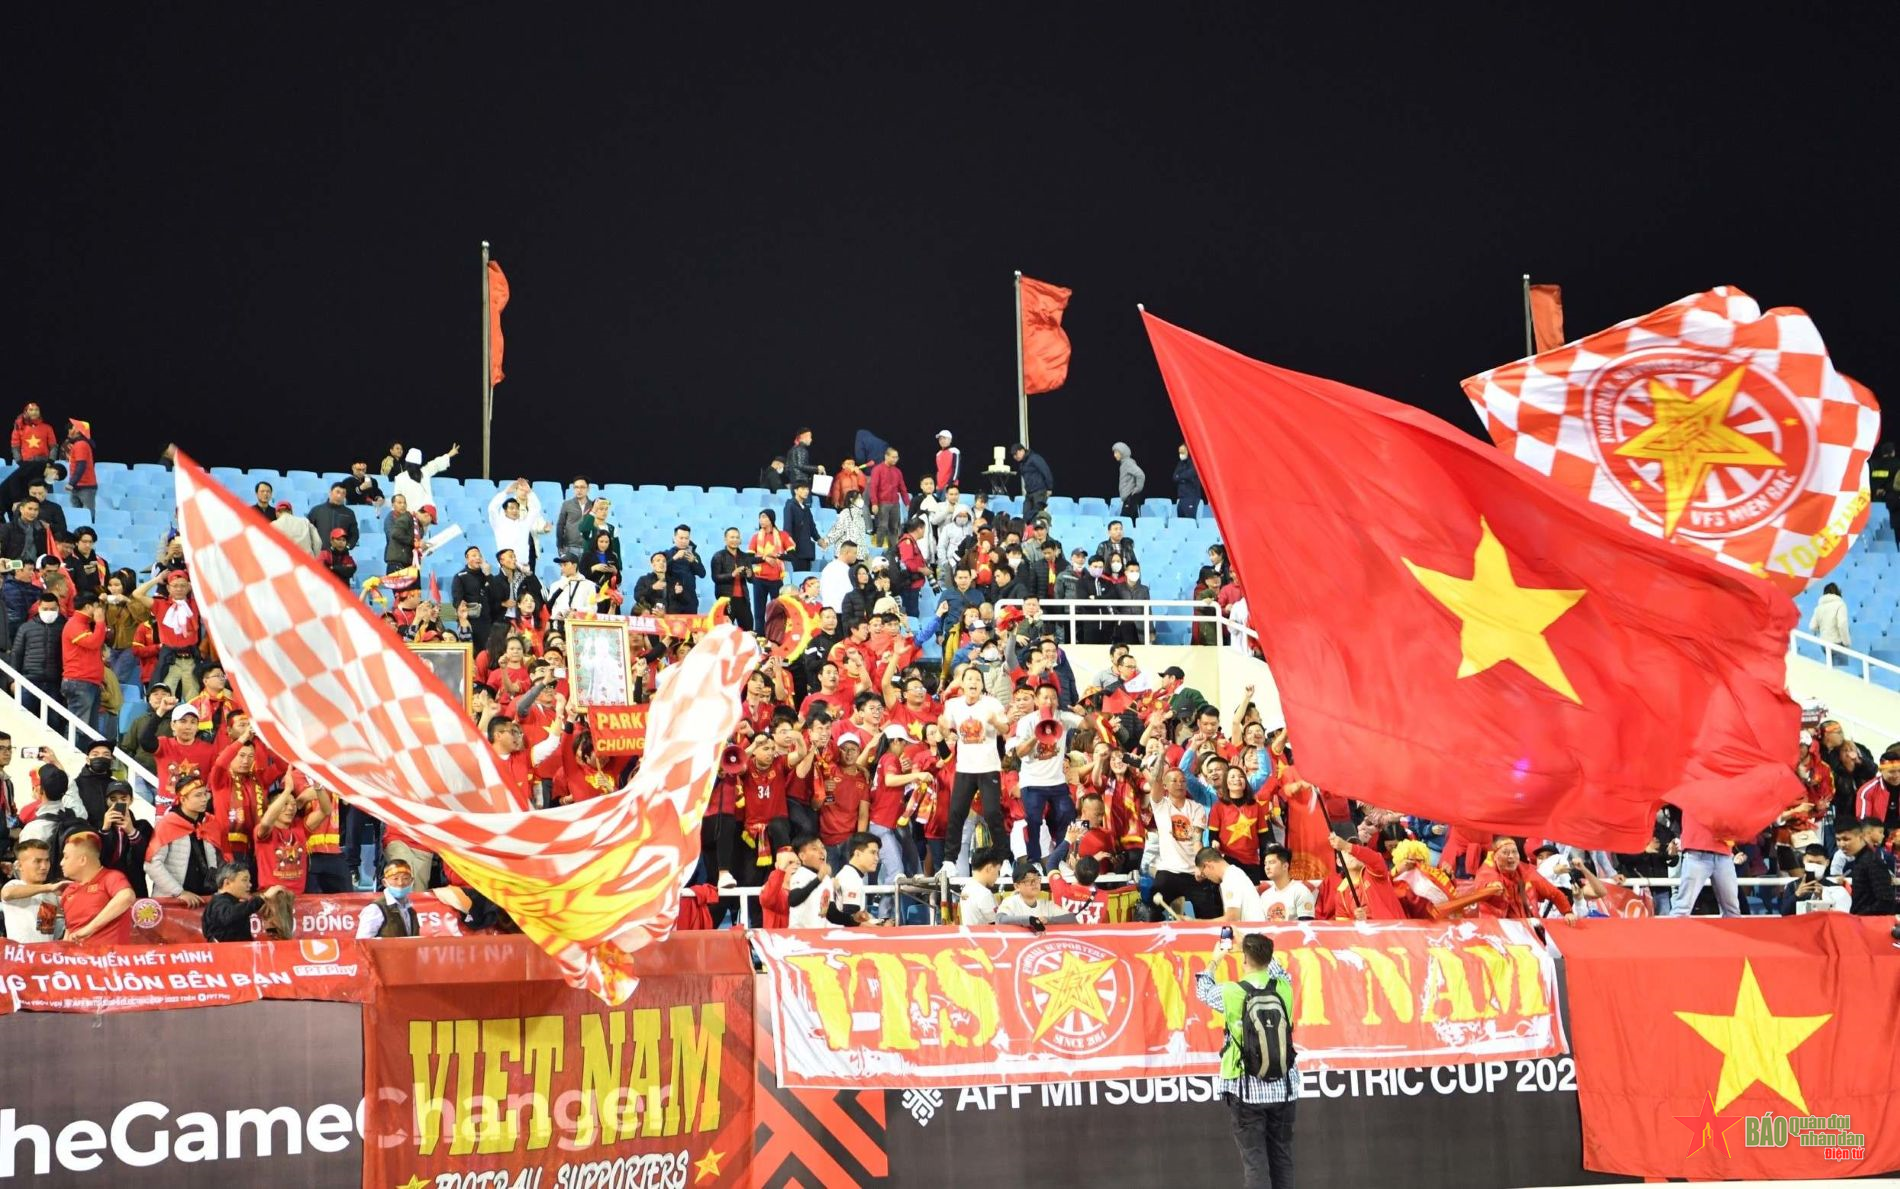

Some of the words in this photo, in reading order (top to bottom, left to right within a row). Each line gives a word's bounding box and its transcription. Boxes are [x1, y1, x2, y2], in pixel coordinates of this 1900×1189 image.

[1690, 509, 1726, 528] VFS
[597, 712, 643, 730] PARK
[597, 735, 645, 751] CHÚNG
[757, 785, 770, 799] 34
[302, 912, 355, 935] ĐỘNG
[417, 912, 442, 927] FS
[134, 949, 166, 966] HẾT
[171, 950, 214, 963] MÌNH
[31, 970, 81, 992] TÔI
[87, 972, 165, 992] LUÔN
[168, 970, 228, 989] BÊN
[231, 971, 292, 988] BẠN
[1055, 1033, 1085, 1050] SINCE
[409, 1014, 564, 1156] VIET
[575, 1002, 726, 1147] NAM
[956, 1084, 1032, 1111] AFF
[1042, 1076, 1222, 1107] MITSUBIS
[1299, 1066, 1424, 1098] ECTRIC
[1430, 1060, 1508, 1094] CUP
[1516, 1057, 1578, 1092] 202
[554, 1150, 689, 1189] SUPPORTERS
